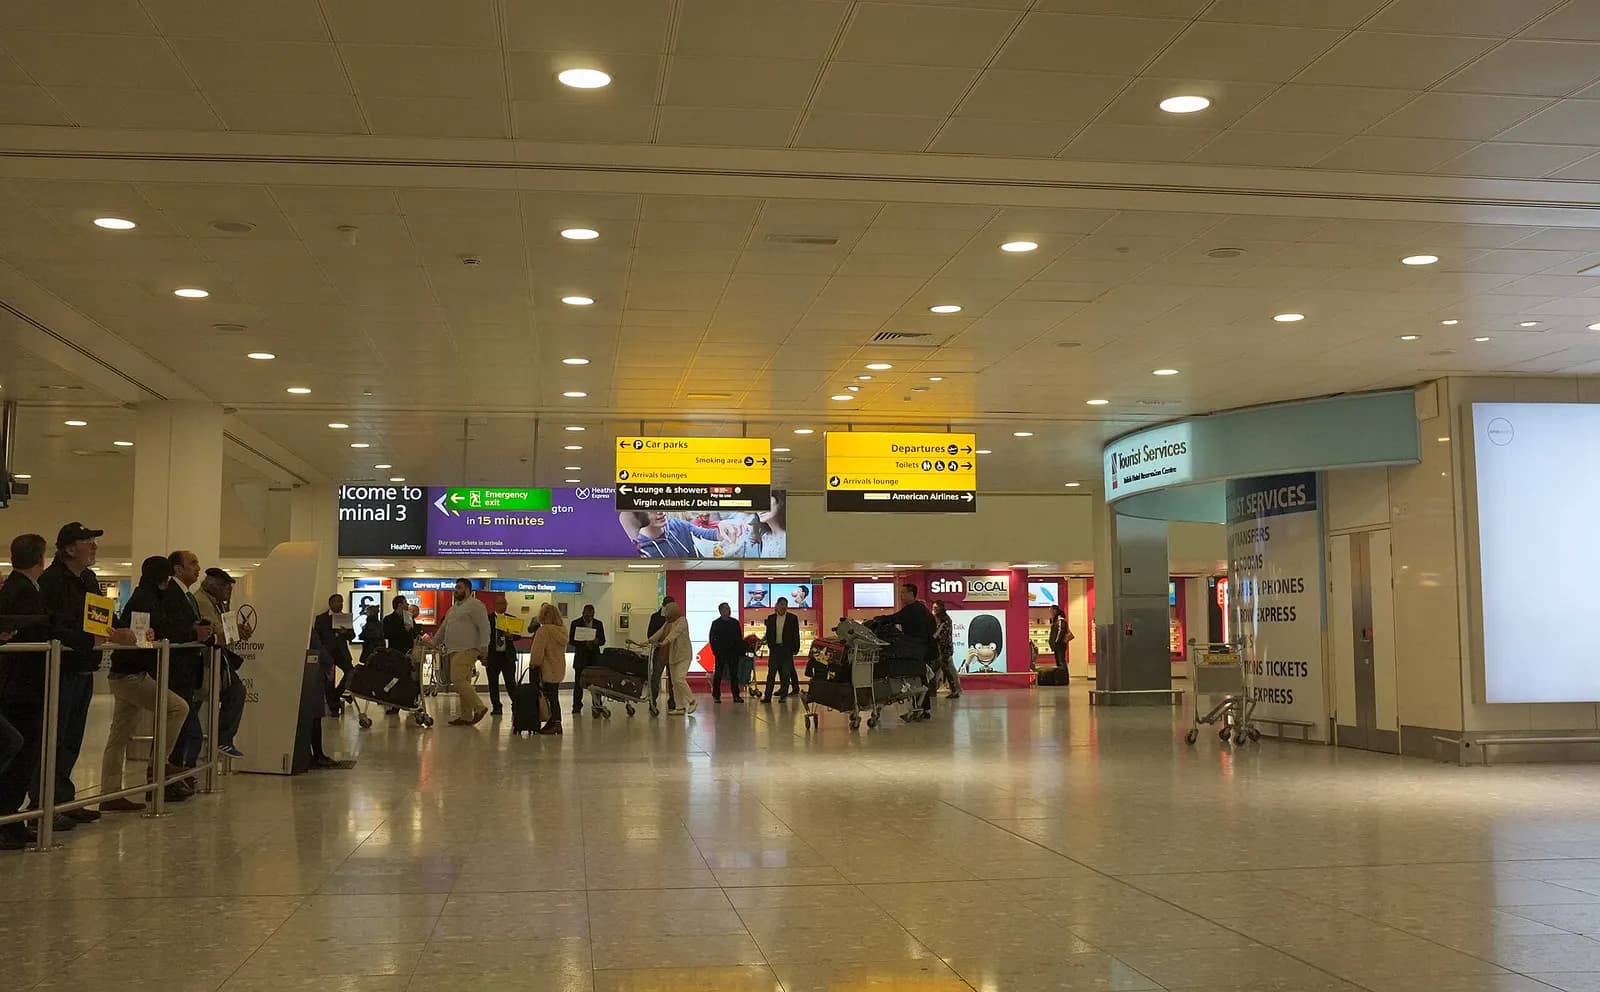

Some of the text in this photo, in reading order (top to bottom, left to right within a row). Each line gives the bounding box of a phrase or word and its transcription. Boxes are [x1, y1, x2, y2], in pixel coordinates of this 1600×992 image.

[664, 440, 688, 450] parks
[892, 444, 945, 454] Departures
[696, 457, 726, 465] Smoking
[1118, 440, 1186, 469] Tourist Services
[339, 485, 422, 500] lcome to
[486, 491, 528, 499] Emergency
[634, 486, 666, 495] Lounge
[1246, 484, 1306, 513] SERVICES
[396, 505, 406, 520] 3
[478, 516, 491, 525] 15
[494, 516, 544, 525] minutes
[931, 578, 1007, 592] sim LOCAL
[1262, 577, 1304, 595] PHONES
[1266, 660, 1308, 678] TICKETS
[1254, 687, 1294, 704] EXPRESS
